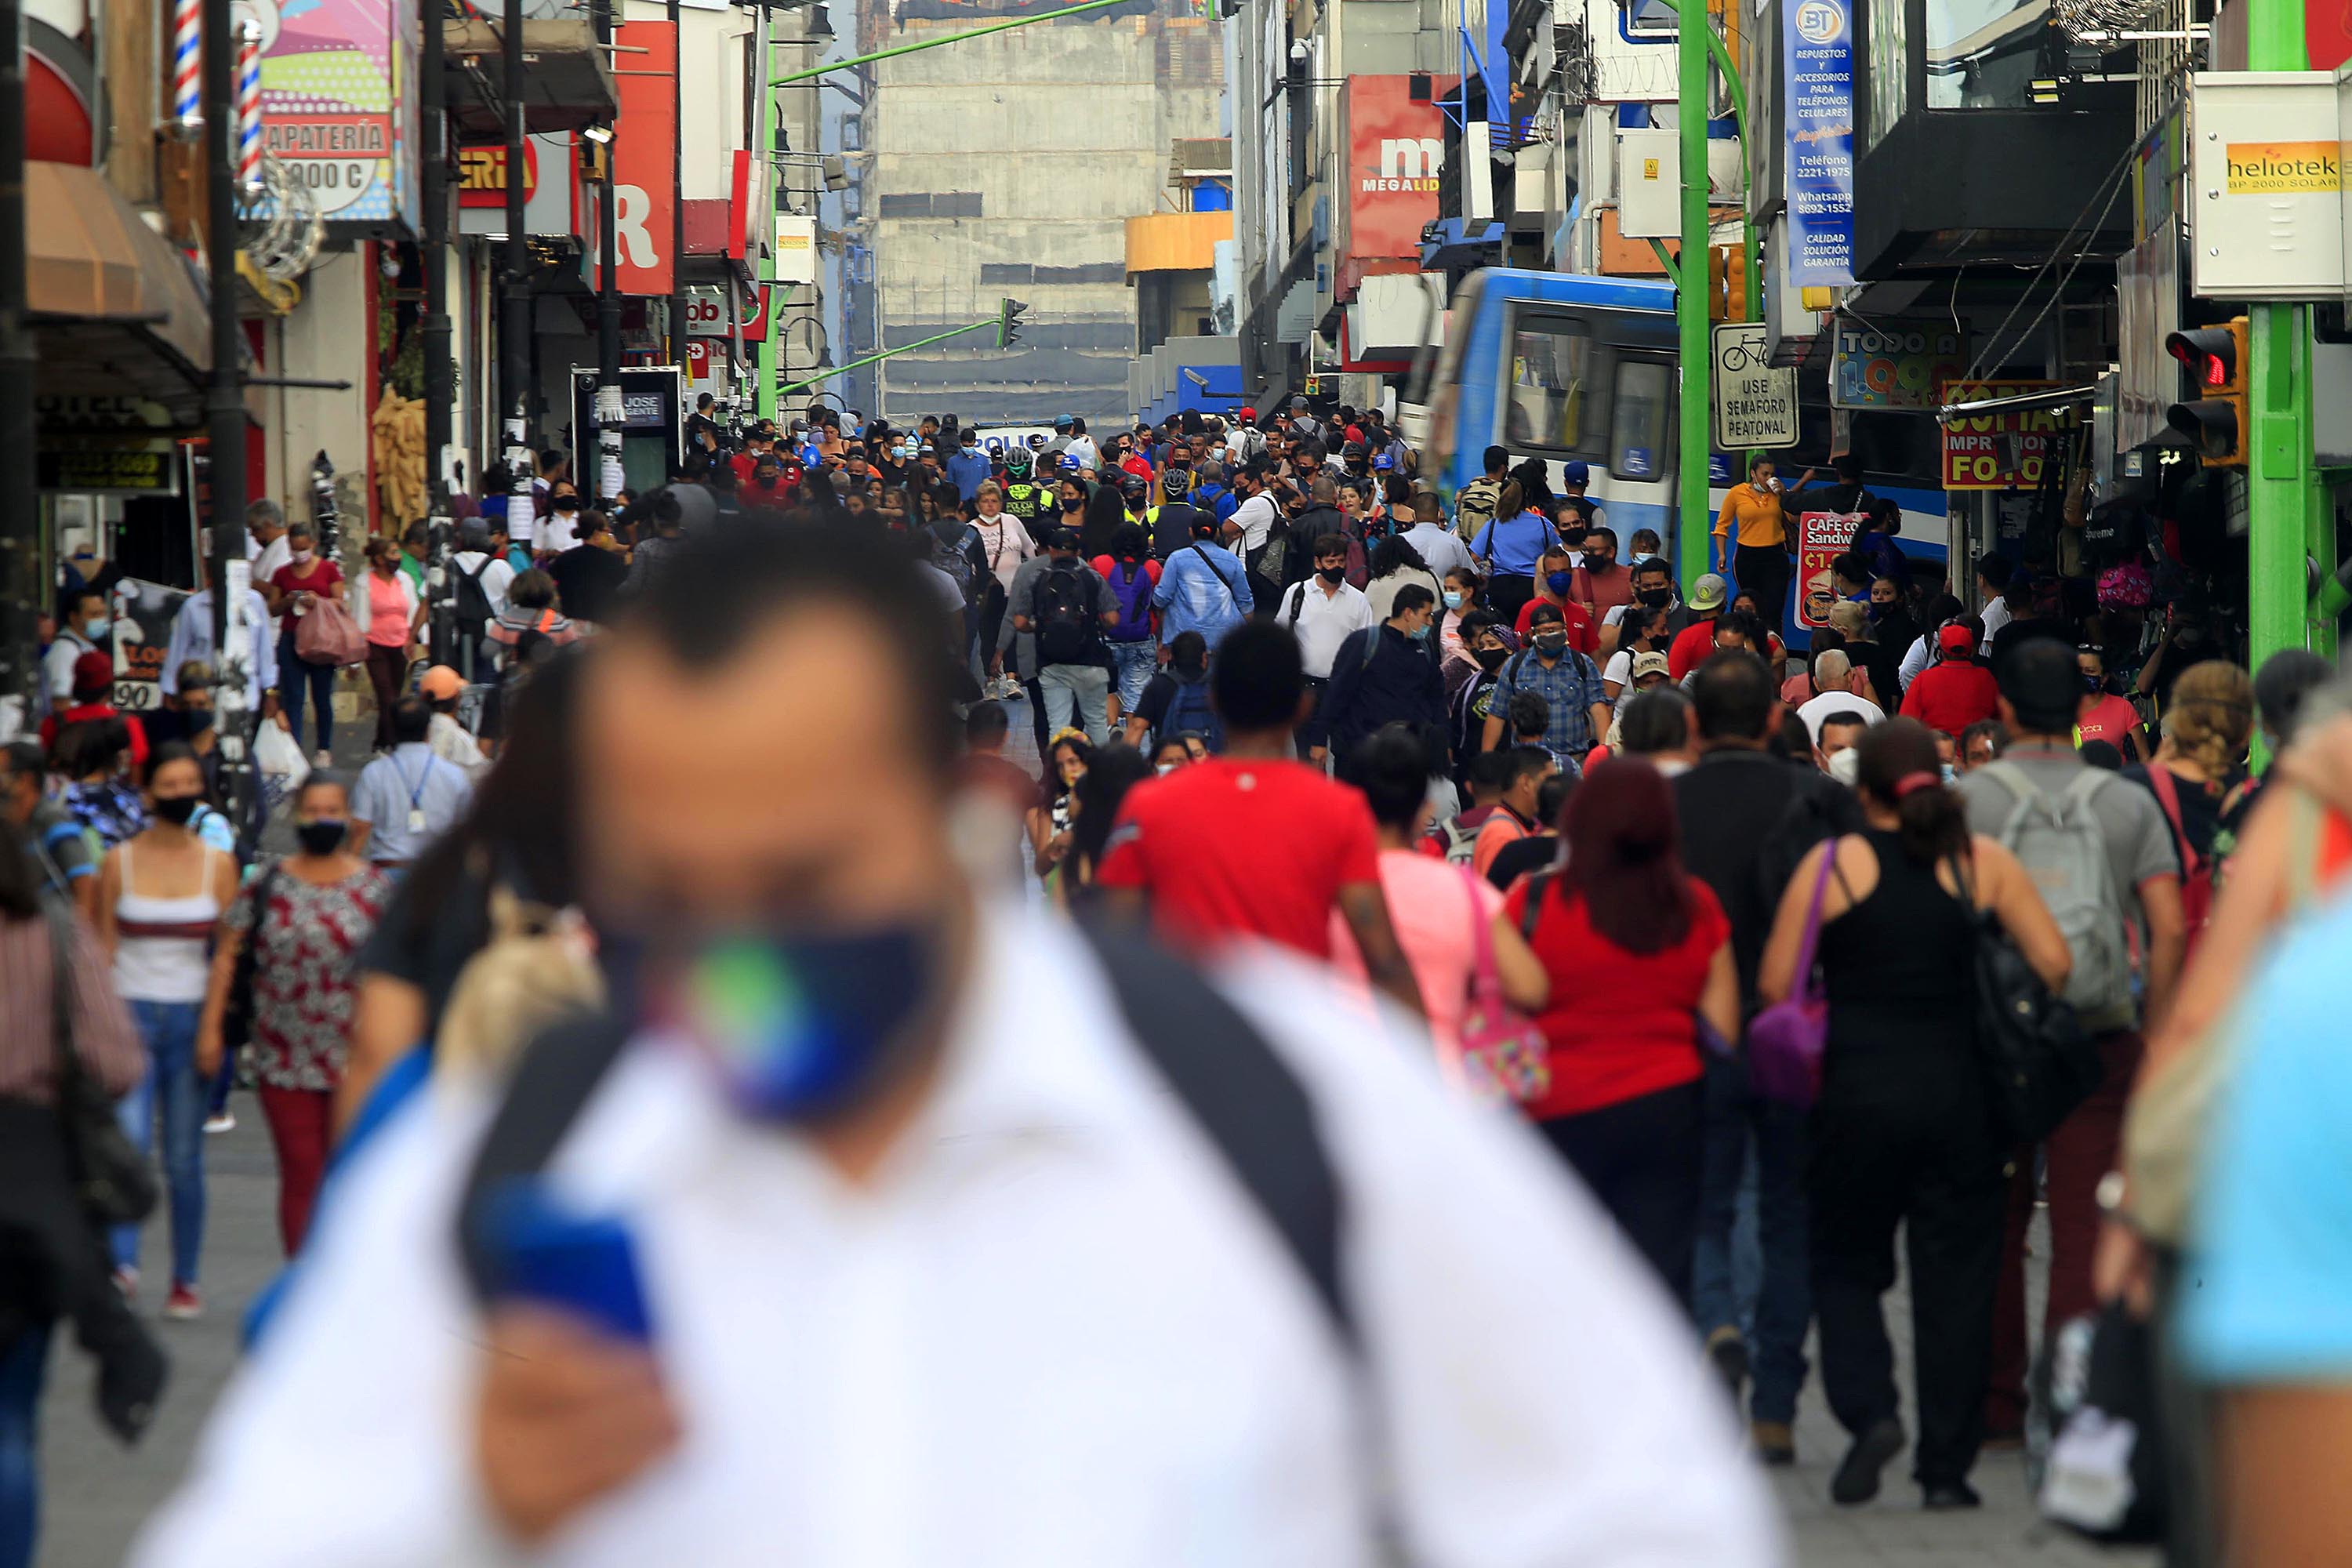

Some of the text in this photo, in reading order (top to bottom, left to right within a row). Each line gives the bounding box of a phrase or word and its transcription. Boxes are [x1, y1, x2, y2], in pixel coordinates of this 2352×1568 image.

[1804, 9, 1830, 31] BT
[1796, 49, 1847, 59] REPUESTOS
[1819, 61, 1825, 71] Y
[1794, 73, 1850, 82] ACCESORIOS
[1809, 85, 1835, 94] PARA
[1797, 95, 1849, 106] TELÉFONOS
[1798, 108, 1848, 118] CELULARES
[1799, 155, 1847, 165] Teléfono
[2227, 156, 2337, 177] heliotek
[349, 163, 361, 188] C
[1797, 167, 1850, 178] 2221-1975
[2252, 180, 2285, 189] 2000
[2289, 178, 2337, 188] SOLAR
[1797, 191, 1852, 203] Whatsapp
[1798, 204, 1852, 214] 8692-1552
[1806, 234, 1846, 244] CALIDAD
[1803, 244, 1849, 255] SOLUCIÓN
[1804, 256, 1849, 267] GARANTÍA
[1842, 332, 1926, 354] TODO
[1742, 379, 1769, 394] USE
[625, 397, 659, 408] JOSE
[1727, 399, 1786, 416] SEMAFORO
[1729, 419, 1786, 436] PEATONAL
[1807, 519, 1841, 532] CAFE
